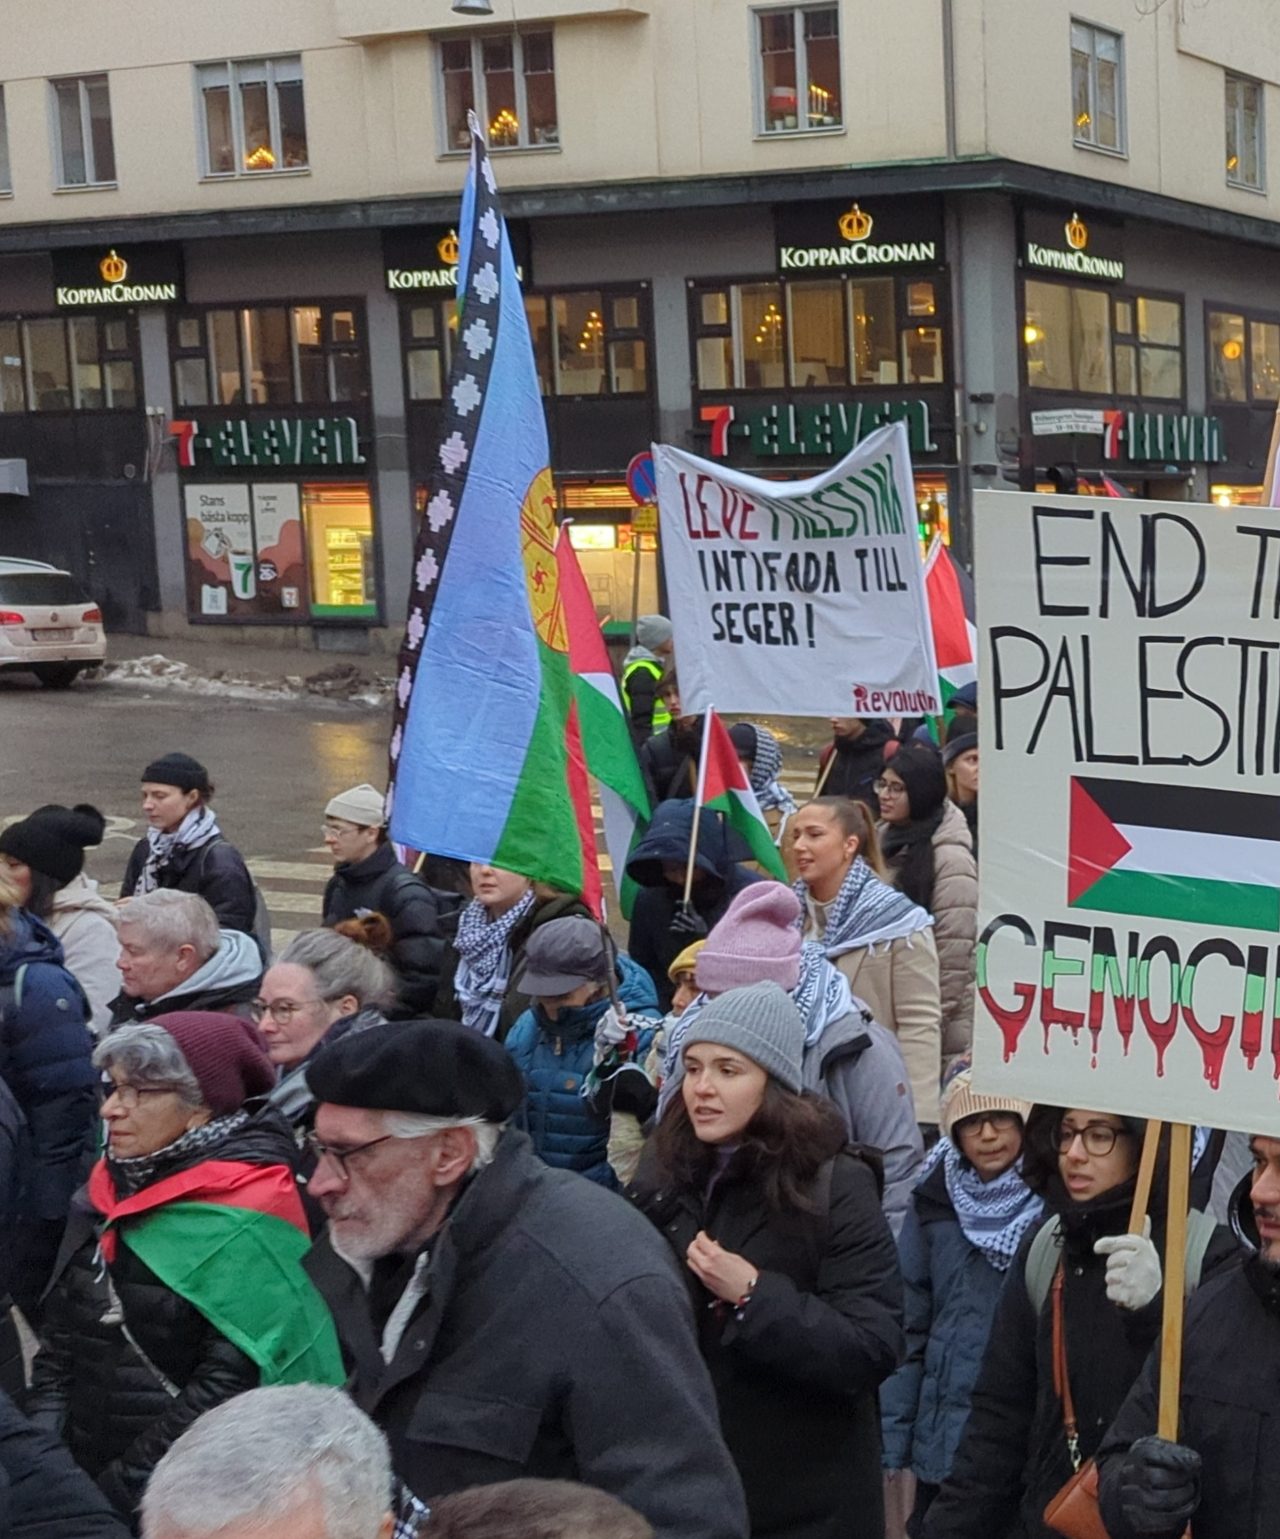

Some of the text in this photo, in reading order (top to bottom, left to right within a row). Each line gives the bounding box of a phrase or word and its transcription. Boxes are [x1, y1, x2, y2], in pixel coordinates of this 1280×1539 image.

[679, 472, 760, 541] LEVE
[698, 547, 908, 594] INTIFADA TILL
[1032, 506, 1207, 618] END
